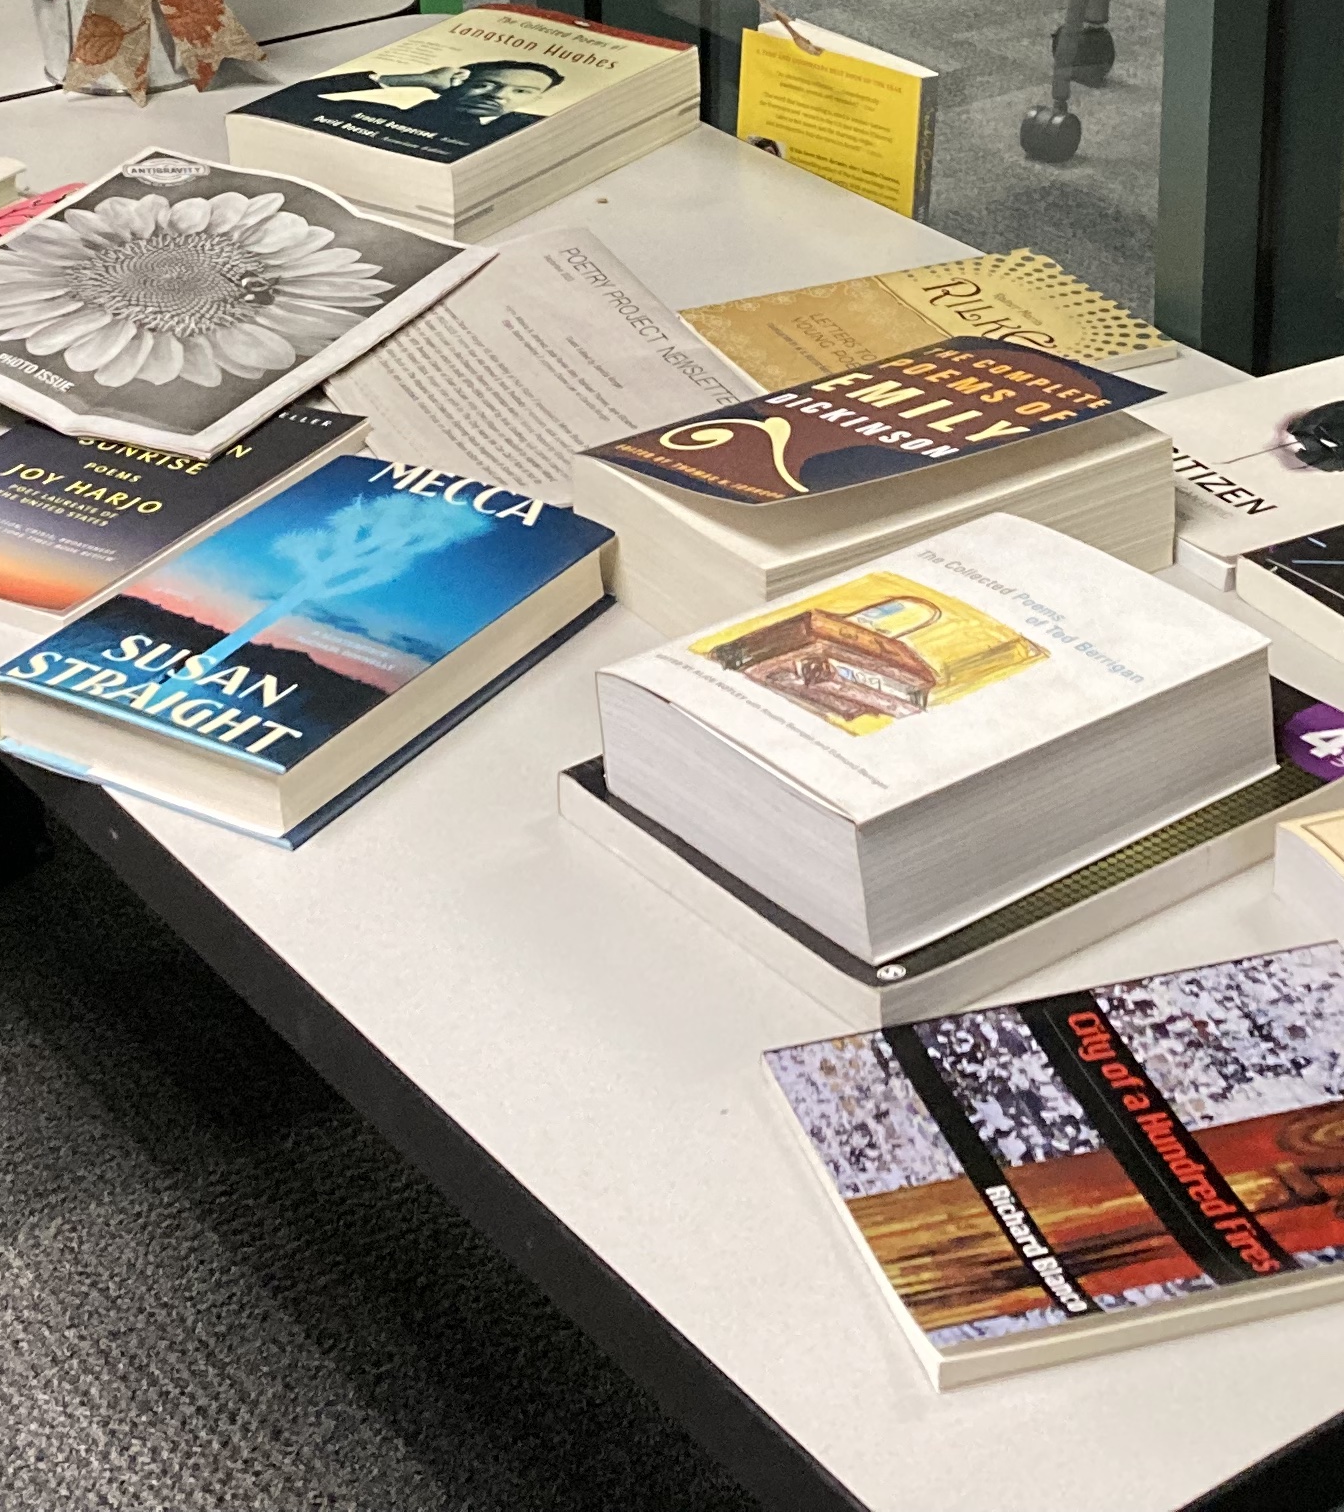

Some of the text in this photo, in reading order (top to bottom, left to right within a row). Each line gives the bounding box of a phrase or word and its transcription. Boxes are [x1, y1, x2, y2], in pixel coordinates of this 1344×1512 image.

[448, 23, 620, 70] Langston Hughes
[573, 34, 607, 48] Poems
[313, 115, 344, 127] David
[351, 112, 387, 125] Arnold
[131, 167, 201, 175] ANTIGRAVITY
[559, 247, 616, 289] POETRY
[602, 289, 669, 344] PROJECT
[657, 345, 742, 406] NEWSLETTE
[792, 317, 835, 349] YOUNG
[831, 350, 862, 369] POE
[806, 313, 861, 348] LETTERS
[855, 348, 878, 362] TO
[33, 369, 75, 393] ISSUE
[810, 372, 1032, 443] EMILY
[878, 357, 1078, 422] POEMS OF
[923, 347, 1113, 410] THE COMPLETE
[763, 392, 960, 459] DICKINSON
[7, 483, 120, 520] POET LAUREATE OF
[64, 479, 164, 515] HARJO
[83, 461, 143, 484] POEMS
[369, 460, 545, 529] MECCA
[1172, 446, 1278, 515] ITIZEN
[19, 497, 66, 516] UNITED
[66, 510, 110, 528] STATES
[917, 549, 1066, 623] The Collected Poems
[102, 634, 299, 708] SUSAN
[1025, 615, 1146, 685] of Ted Berrigan
[6, 651, 303, 754] STRAIGHT
[1067, 1010, 1282, 1274] City of a Hundred Fires
[985, 1184, 1089, 1313] Richard Blanco
